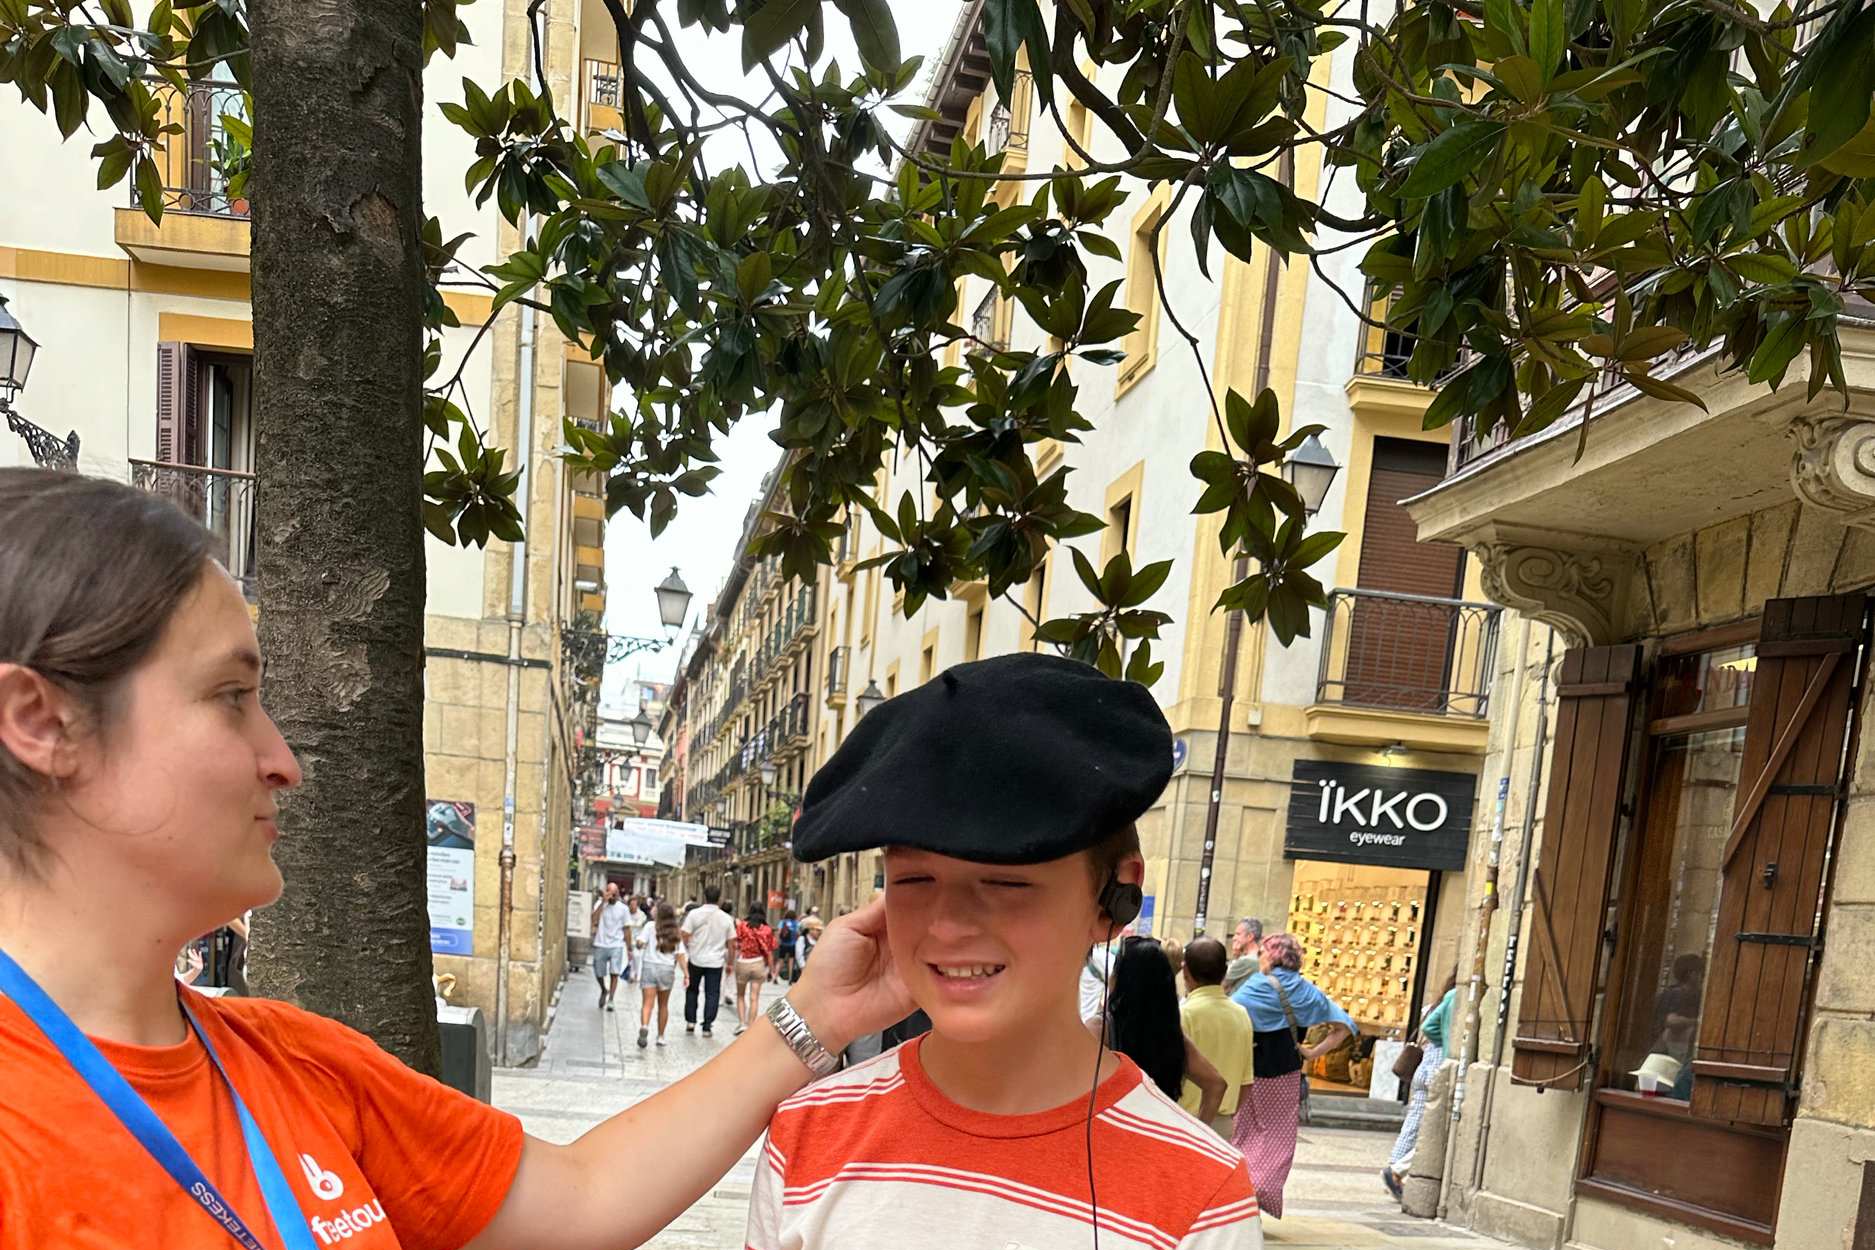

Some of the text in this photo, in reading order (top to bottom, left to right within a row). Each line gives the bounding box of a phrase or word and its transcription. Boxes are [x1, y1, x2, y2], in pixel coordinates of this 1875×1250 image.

[1318, 779, 1448, 831] ÏKKO
[1350, 831, 1406, 846] eyewear
[311, 1198, 387, 1245] feetou
